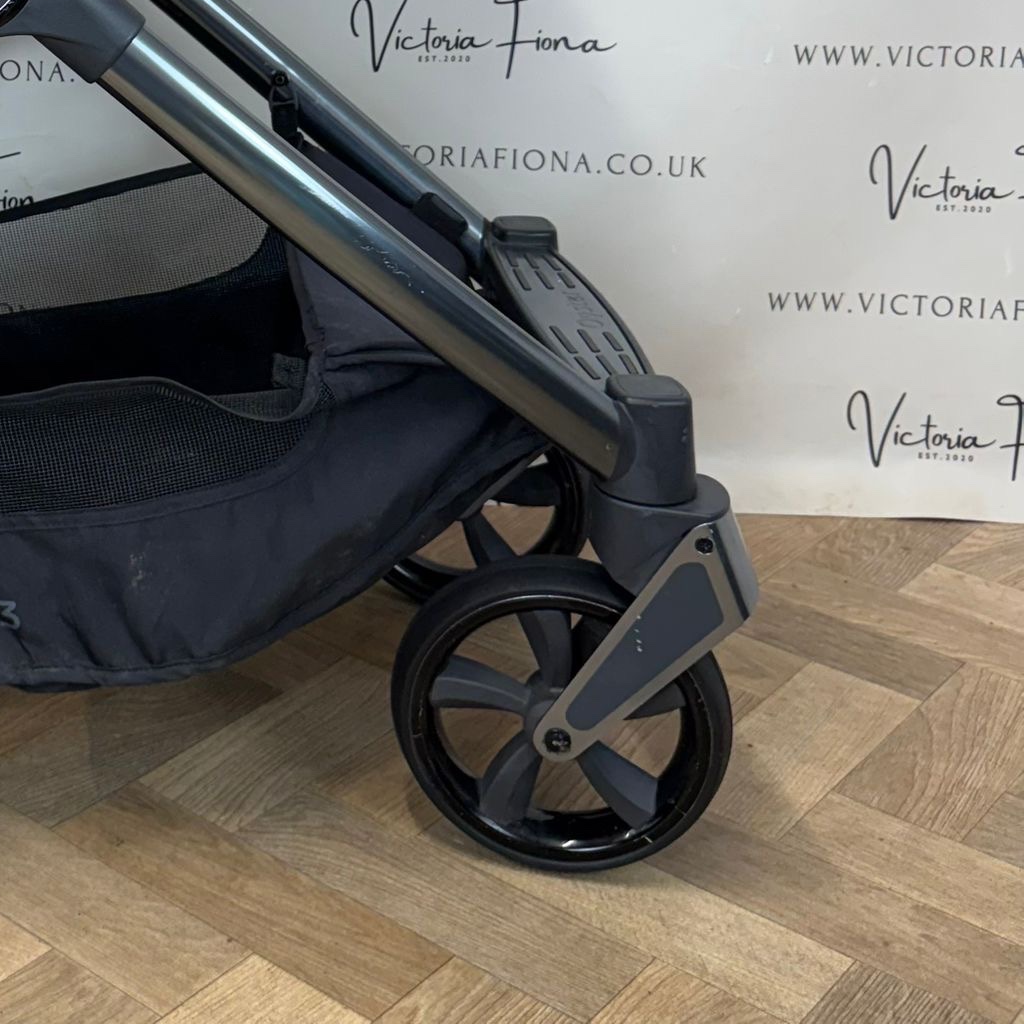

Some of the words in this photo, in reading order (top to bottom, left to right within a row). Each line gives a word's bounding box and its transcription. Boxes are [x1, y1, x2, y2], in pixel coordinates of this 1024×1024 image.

[417, 54, 471, 63] EST.2020
[401, 145, 706, 178] ORIAFIONA.CO.UK
[869, 144, 1016, 220] Victoria
[935, 203, 992, 214] EST.2020
[847, 390, 997, 468] Victoria
[917, 451, 975, 463] EST.2020
